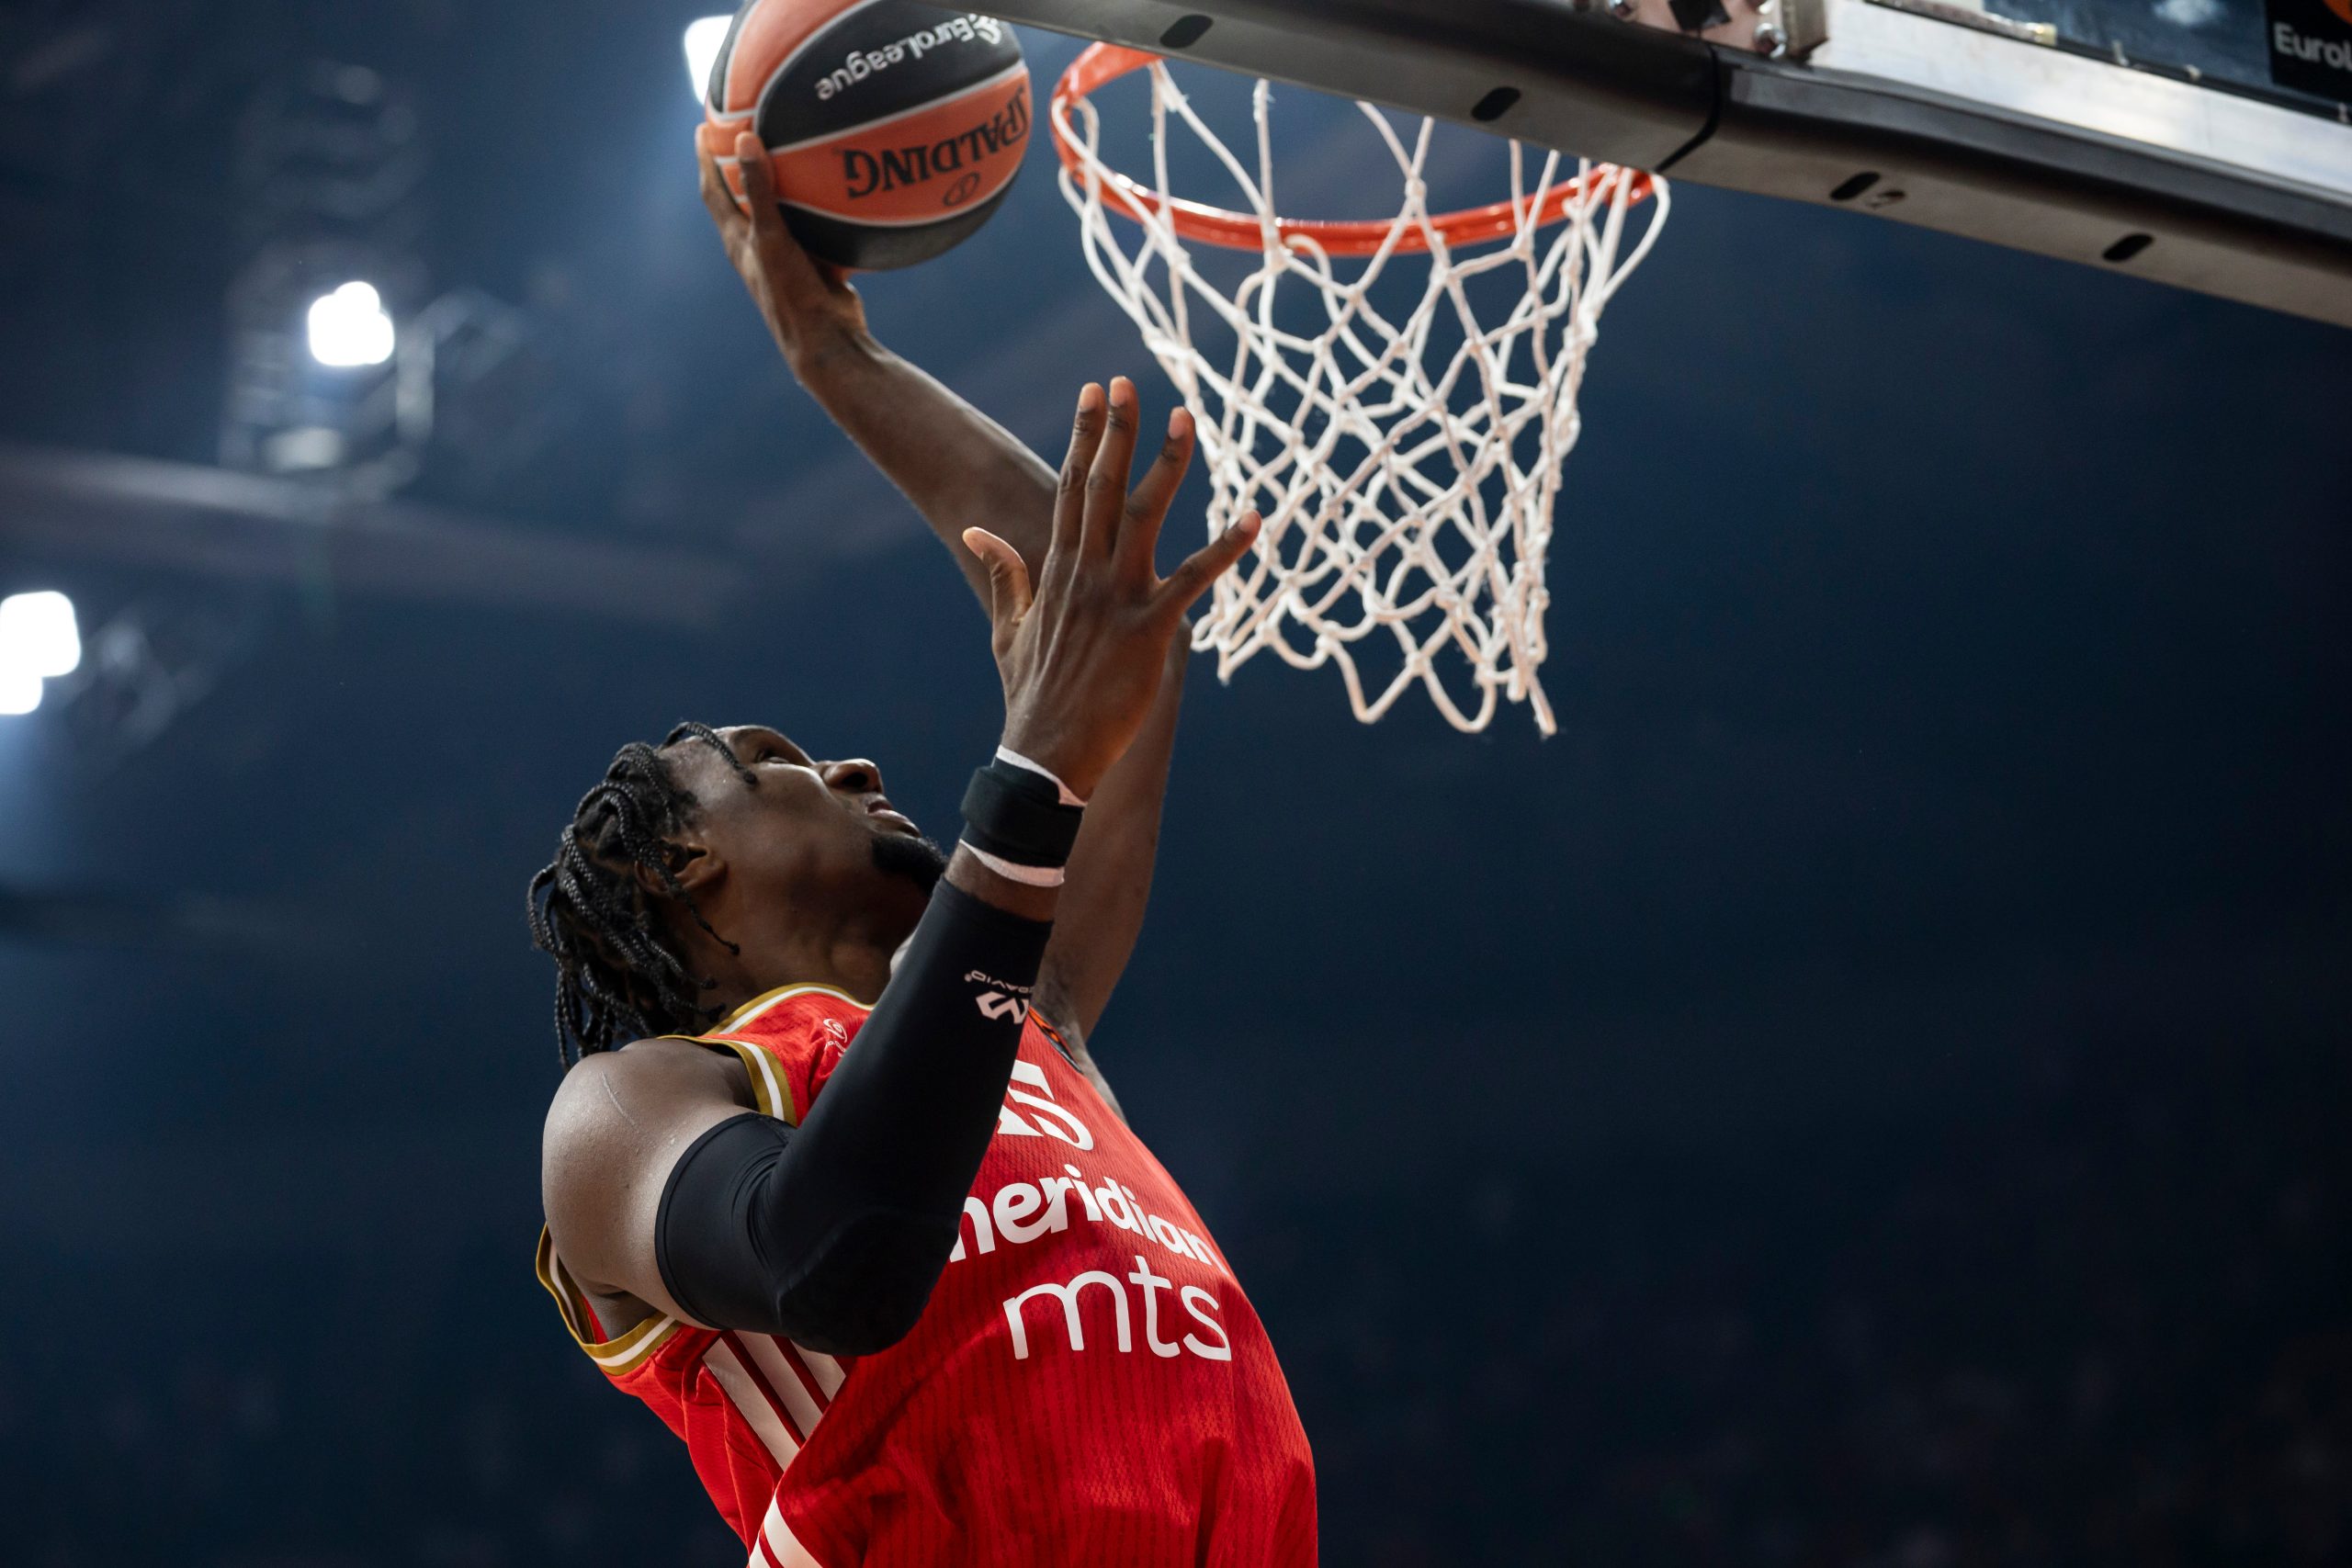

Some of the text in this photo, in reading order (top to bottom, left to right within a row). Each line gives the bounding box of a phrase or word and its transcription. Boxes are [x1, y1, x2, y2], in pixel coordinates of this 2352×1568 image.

[815, 16, 975, 100] EuroLeague
[843, 86, 1029, 198] SPALDING
[1002, 1255, 1232, 1361] mts
